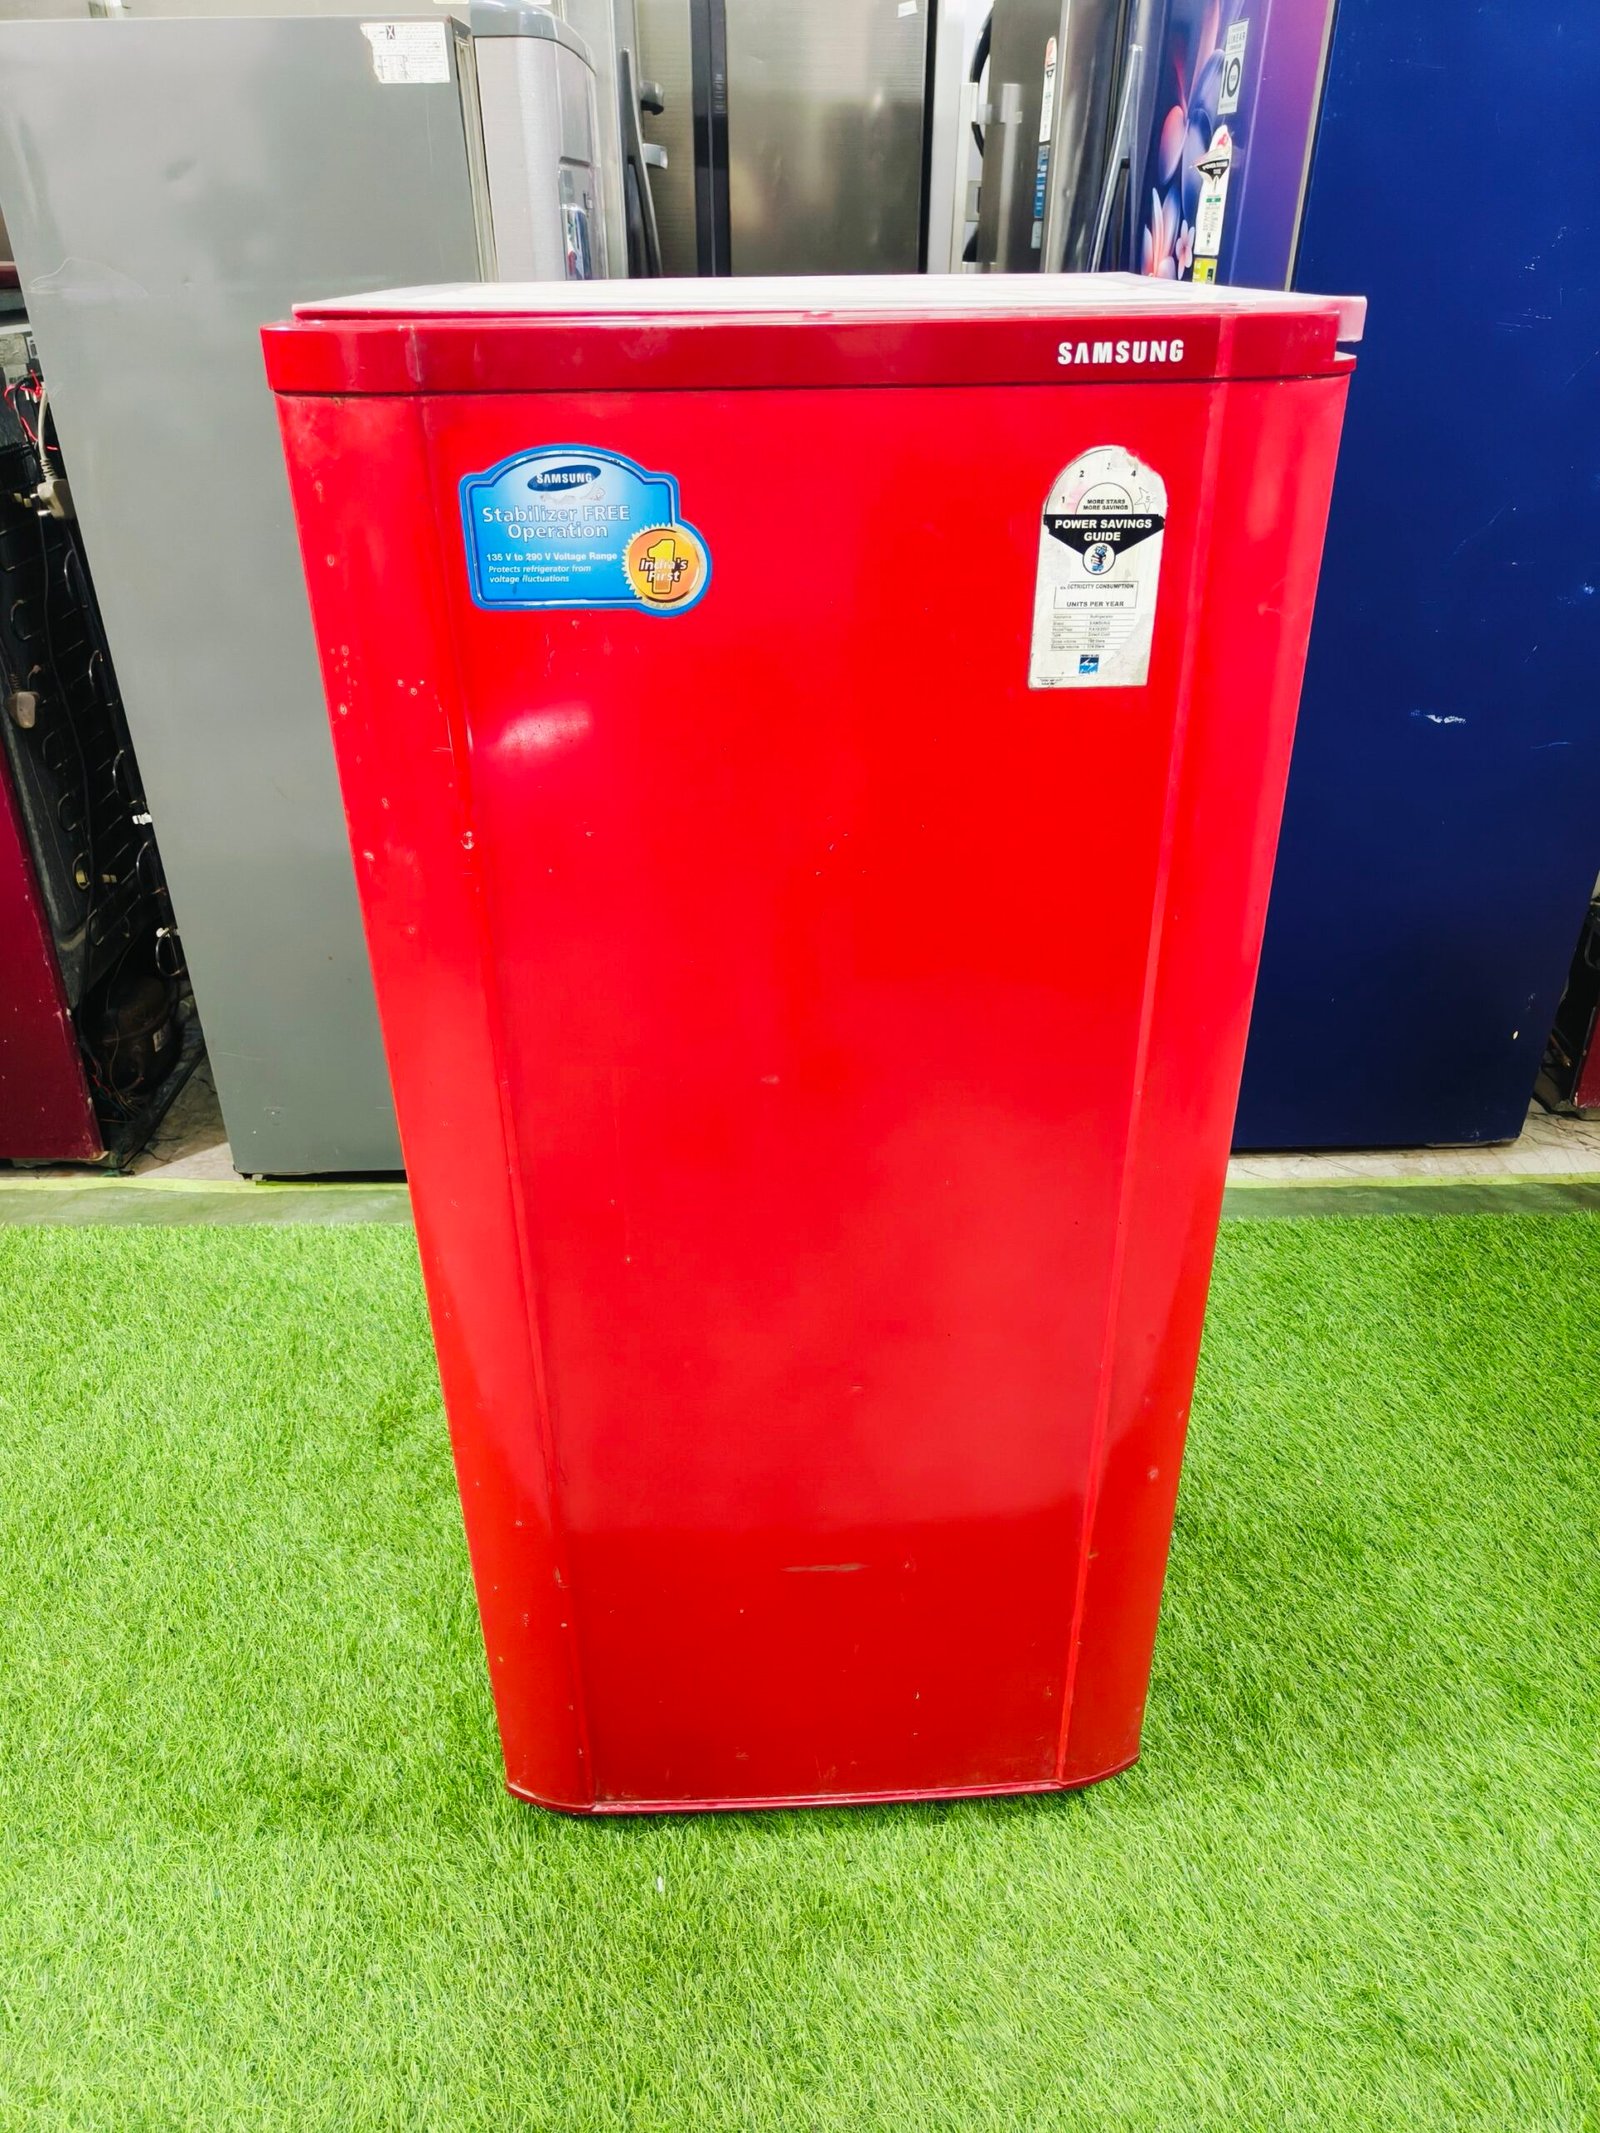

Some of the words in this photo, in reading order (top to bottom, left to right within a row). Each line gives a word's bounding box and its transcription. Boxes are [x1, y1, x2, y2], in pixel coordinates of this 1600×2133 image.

[1057, 339, 1185, 365] SAMSUNG
[536, 471, 592, 484] SAMSUNG
[482, 506, 577, 523] Stabilizer
[582, 505, 630, 521] FREE
[1055, 519, 1097, 529] POWER
[1100, 519, 1152, 528] SAVINGS
[507, 523, 608, 542] Operation
[1084, 531, 1121, 541] GUIDE
[505, 553, 511, 561] V
[514, 553, 523, 561] to
[554, 552, 586, 562] Voltage
[589, 552, 618, 561] Range
[523, 565, 570, 574] refrigerator
[639, 557, 688, 571] India's
[490, 575, 520, 584] voltage
[522, 575, 570, 583] fluctuations
[647, 570, 681, 583] First
